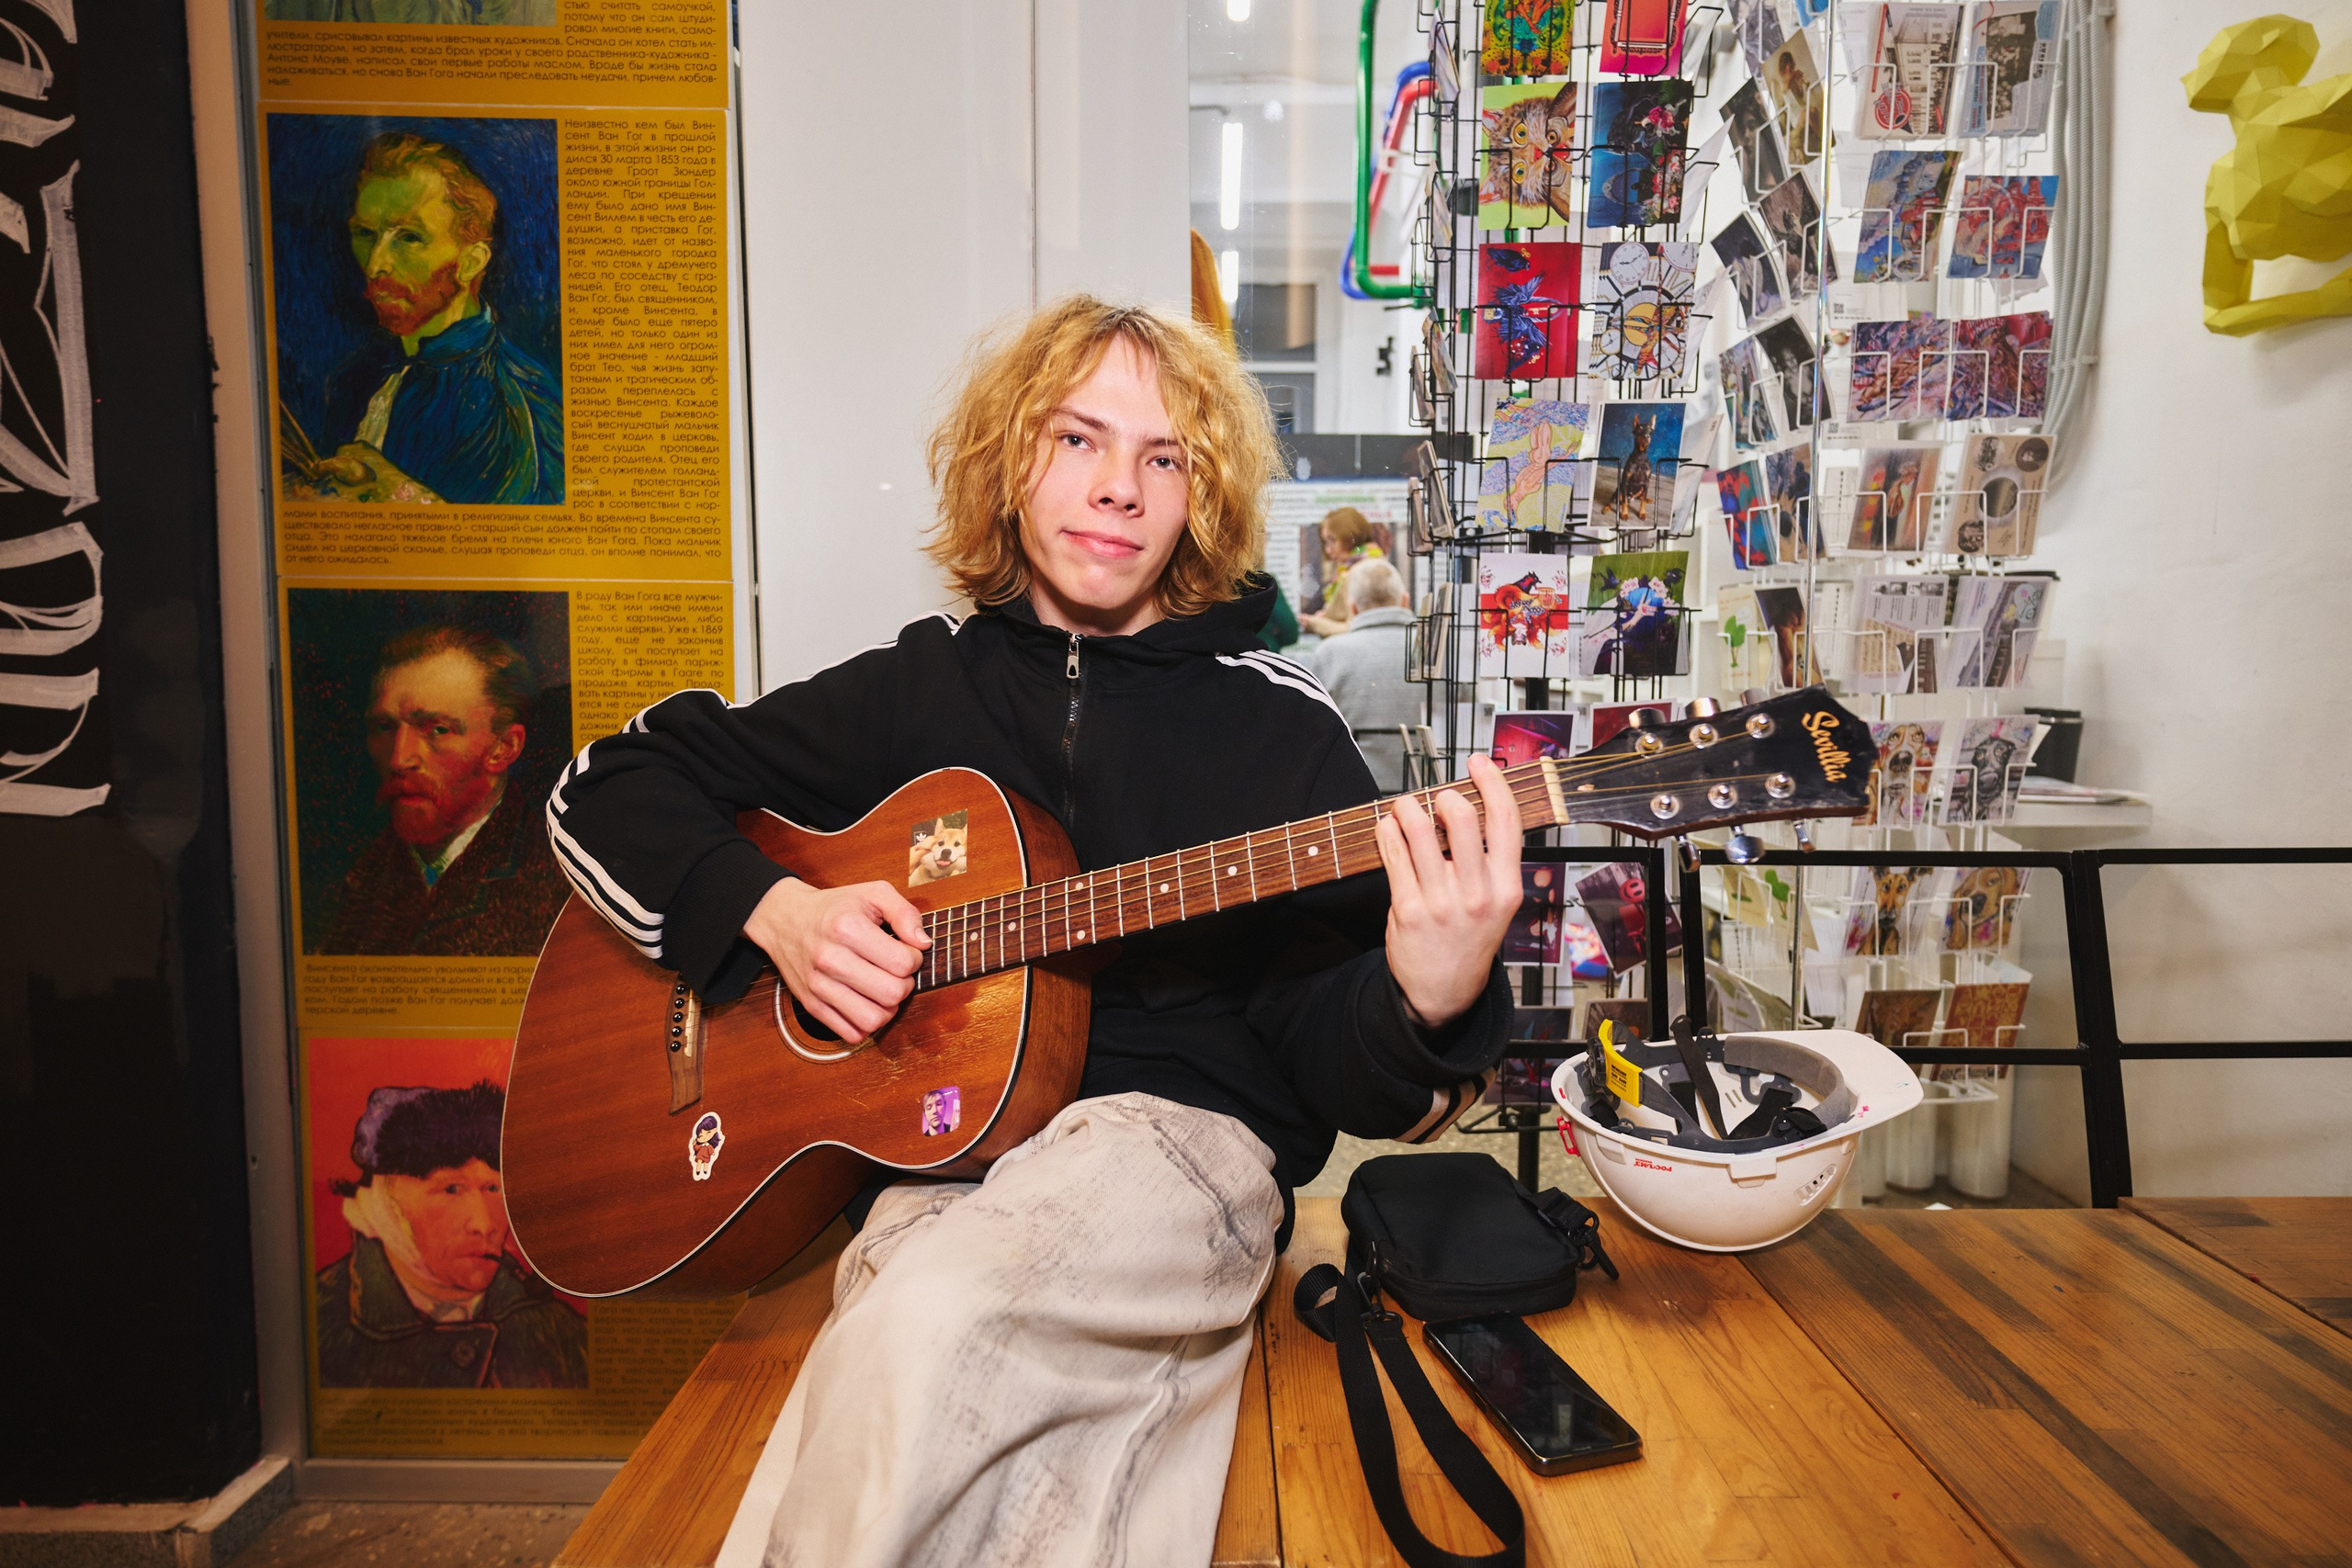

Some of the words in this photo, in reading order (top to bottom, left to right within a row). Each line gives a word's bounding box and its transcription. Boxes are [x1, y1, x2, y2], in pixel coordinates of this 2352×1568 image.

[564, 14, 605, 24] потому
[679, 16, 716, 25] штуди-
[564, 26, 597, 35] ровал
[386, 35, 434, 45] картины
[566, 37, 616, 46] Сначала
[441, 59, 483, 69] первые
[487, 58, 529, 70] работы
[590, 61, 625, 72] Вроде
[628, 62, 644, 70] бы
[565, 119, 628, 129] Неизвестно
[664, 120, 685, 130] был
[693, 121, 715, 130] Вин-
[598, 131, 619, 141] Ван
[627, 132, 643, 141] Гог
[664, 132, 716, 143] прошлой
[565, 168, 614, 177] деревне
[628, 167, 659, 178] Гроот
[673, 167, 717, 179] Зюндер
[603, 178, 641, 187] южной
[644, 180, 691, 190] границы
[695, 179, 716, 188] Гол-
[622, 190, 645, 201] При
[658, 192, 717, 202] крещении
[631, 227, 689, 236] приставка
[633, 238, 656, 247] идет
[672, 251, 717, 260] городка
[568, 293, 589, 302] Ван
[614, 294, 635, 303] был
[677, 398, 718, 410] Каждое
[571, 411, 642, 420] воскресенье
[661, 412, 718, 421] рыжеволо-
[571, 420, 593, 429] сый
[597, 420, 669, 432] веснушчатый
[571, 432, 615, 440] Винсент
[622, 434, 653, 443] ходил
[571, 445, 589, 454] где
[604, 445, 645, 455] слушал
[661, 446, 719, 456] проповеди
[670, 455, 698, 466] Отец
[572, 466, 593, 474] был
[599, 468, 667, 478] служителем
[673, 468, 718, 478] голланд-
[573, 476, 599, 485] ской
[634, 477, 720, 489] протестантской
[451, 534, 488, 545] бремя
[587, 536, 607, 545] Ван
[644, 536, 672, 546] Пока
[585, 593, 612, 603] роду
[615, 592, 635, 601] Ван
[638, 592, 661, 601] Гога
[685, 594, 722, 604] мужчи-
[577, 615, 603, 625] дело
[697, 615, 723, 623] либо
[578, 626, 623, 635] служили
[669, 625, 689, 634] Уже
[702, 626, 722, 634] 1869
[616, 637, 639, 647] еще
[647, 648, 700, 658] поступает
[579, 657, 616, 668] работу
[636, 657, 678, 669] филиал
[685, 660, 724, 669] париж-
[579, 667, 604, 676] ской
[611, 668, 653, 679] фирмы
[673, 668, 703, 677] Гааге
[579, 680, 627, 690] продаже
[686, 680, 724, 691] Прода-
[603, 691, 647, 700] картины
[580, 712, 618, 721] однако
[580, 722, 619, 731] дожник
[1802, 711, 1851, 783] Sevillia
